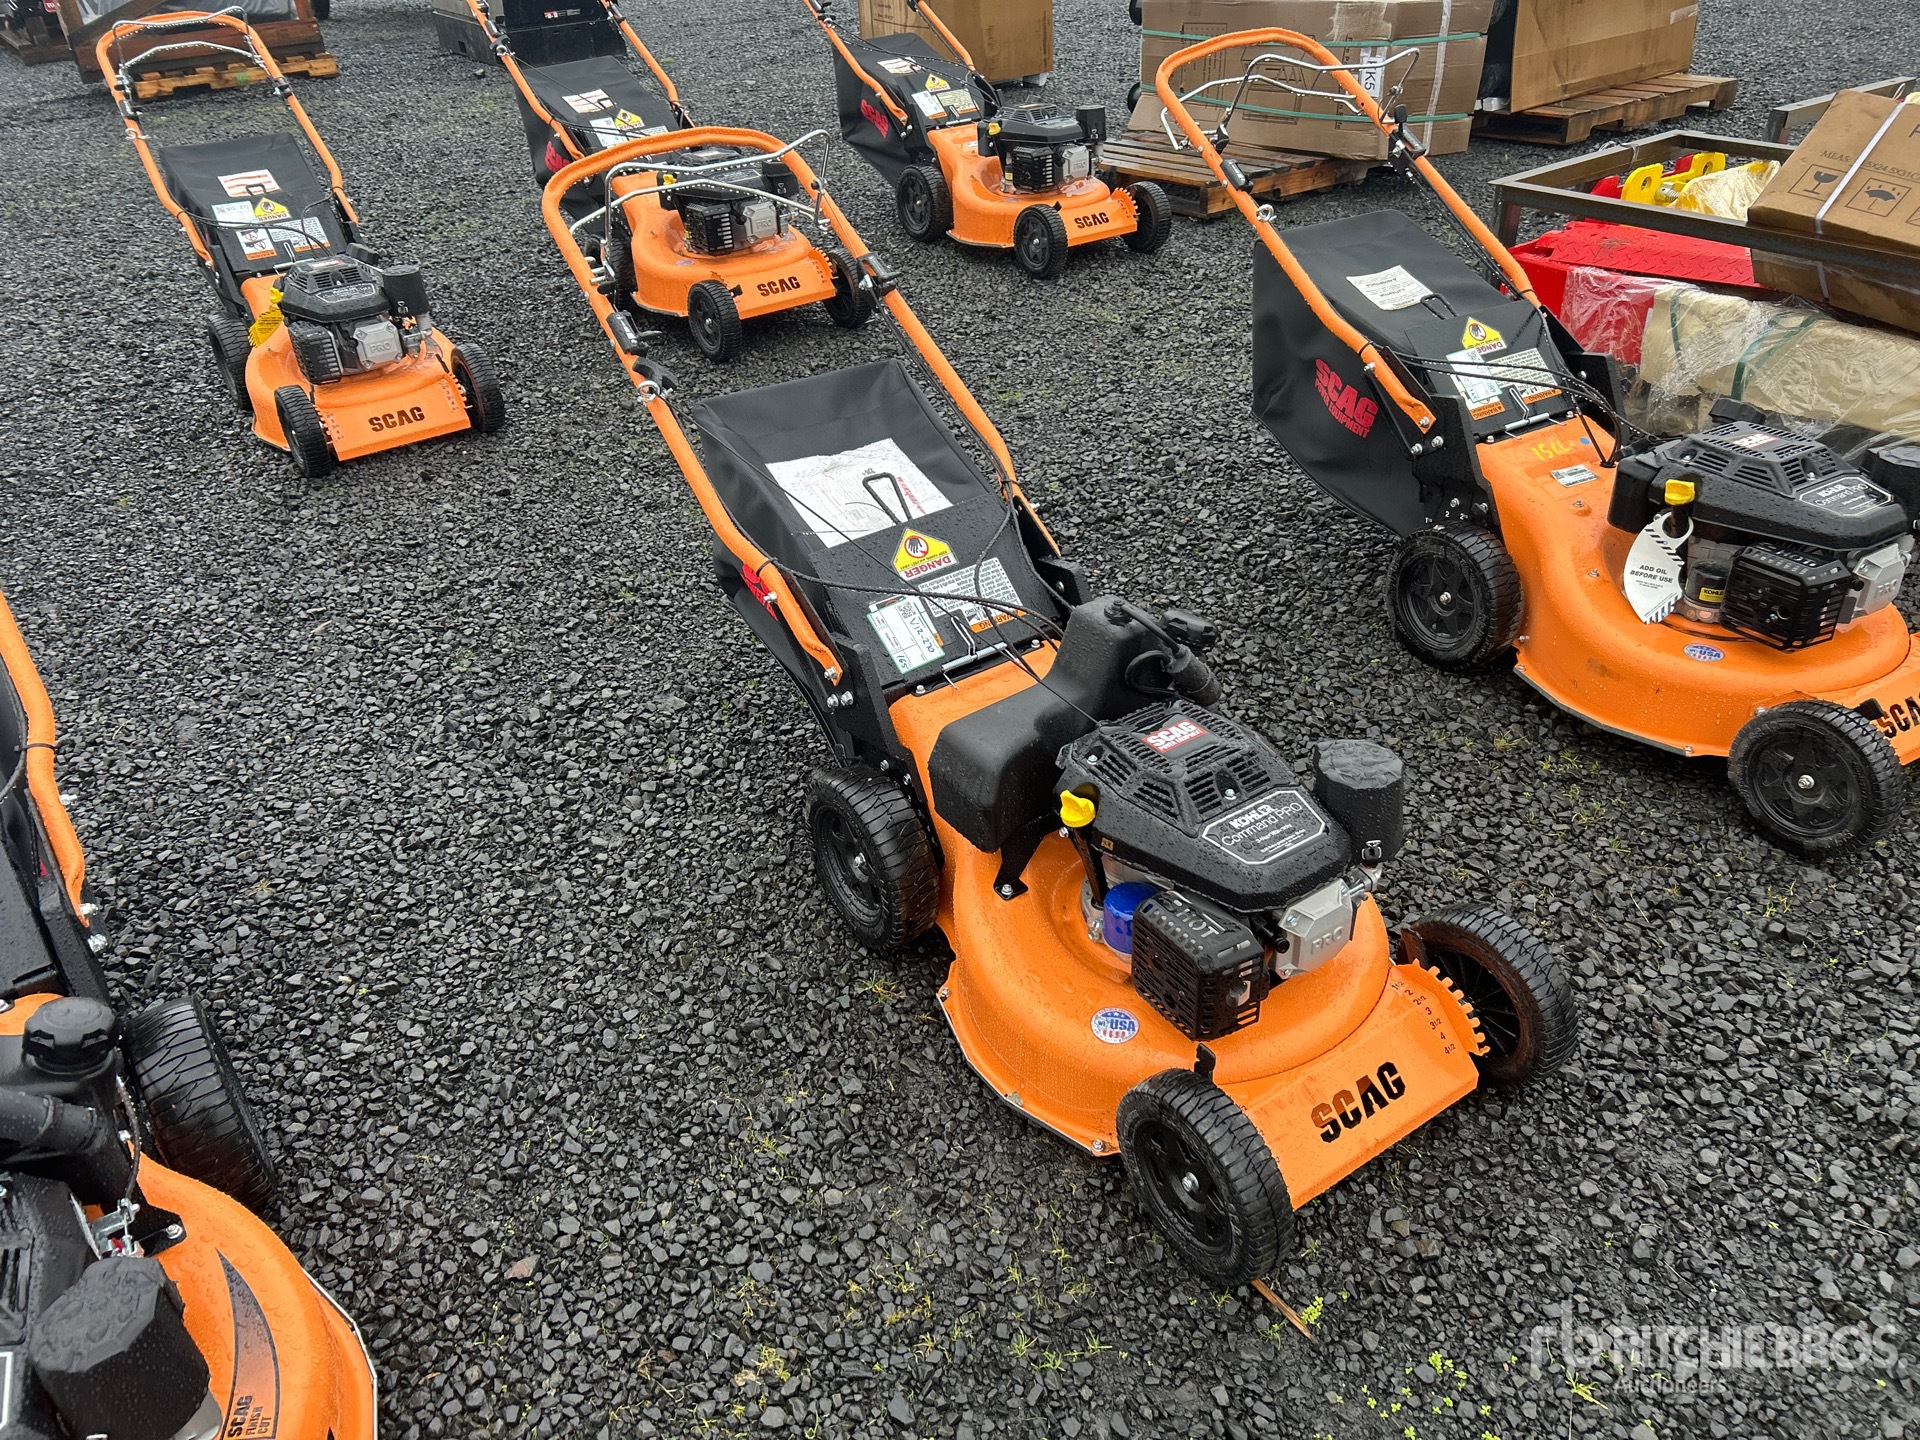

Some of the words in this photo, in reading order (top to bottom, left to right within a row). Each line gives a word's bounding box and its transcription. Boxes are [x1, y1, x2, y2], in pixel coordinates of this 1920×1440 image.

[1074, 212, 1109, 228] SCAG
[757, 276, 801, 297] SCAG
[370, 341, 392, 353] PRO
[1315, 358, 1379, 427] SCAG
[368, 406, 426, 432] SCAG
[1328, 401, 1370, 438] EQUIPMENT
[905, 556, 952, 578] DANGER
[1630, 570, 1658, 580] BEFORE
[1659, 575, 1673, 584] USE
[1639, 564, 1655, 572] ADD
[1656, 567, 1667, 575] OIL
[1703, 588, 1724, 596] KOHLE
[897, 655, 909, 669] 165
[1699, 650, 1722, 659] USA
[1877, 696, 1920, 739] SCA
[1147, 721, 1198, 747] SCAG
[1221, 813, 1278, 846] Command
[1274, 802, 1303, 820] PRO
[1229, 804, 1277, 829] KOHLER
[1175, 907, 1220, 938] HOT
[1311, 925, 1345, 954] PRO
[1425, 1006, 1432, 1015] 3
[1110, 1019, 1135, 1031] USA
[1440, 1031, 1446, 1040] 4
[1311, 1061, 1406, 1143] SCAG
[228, 1395, 252, 1437] SCAG
[246, 1406, 263, 1435] FINISH
[258, 1416, 271, 1434] CUT
